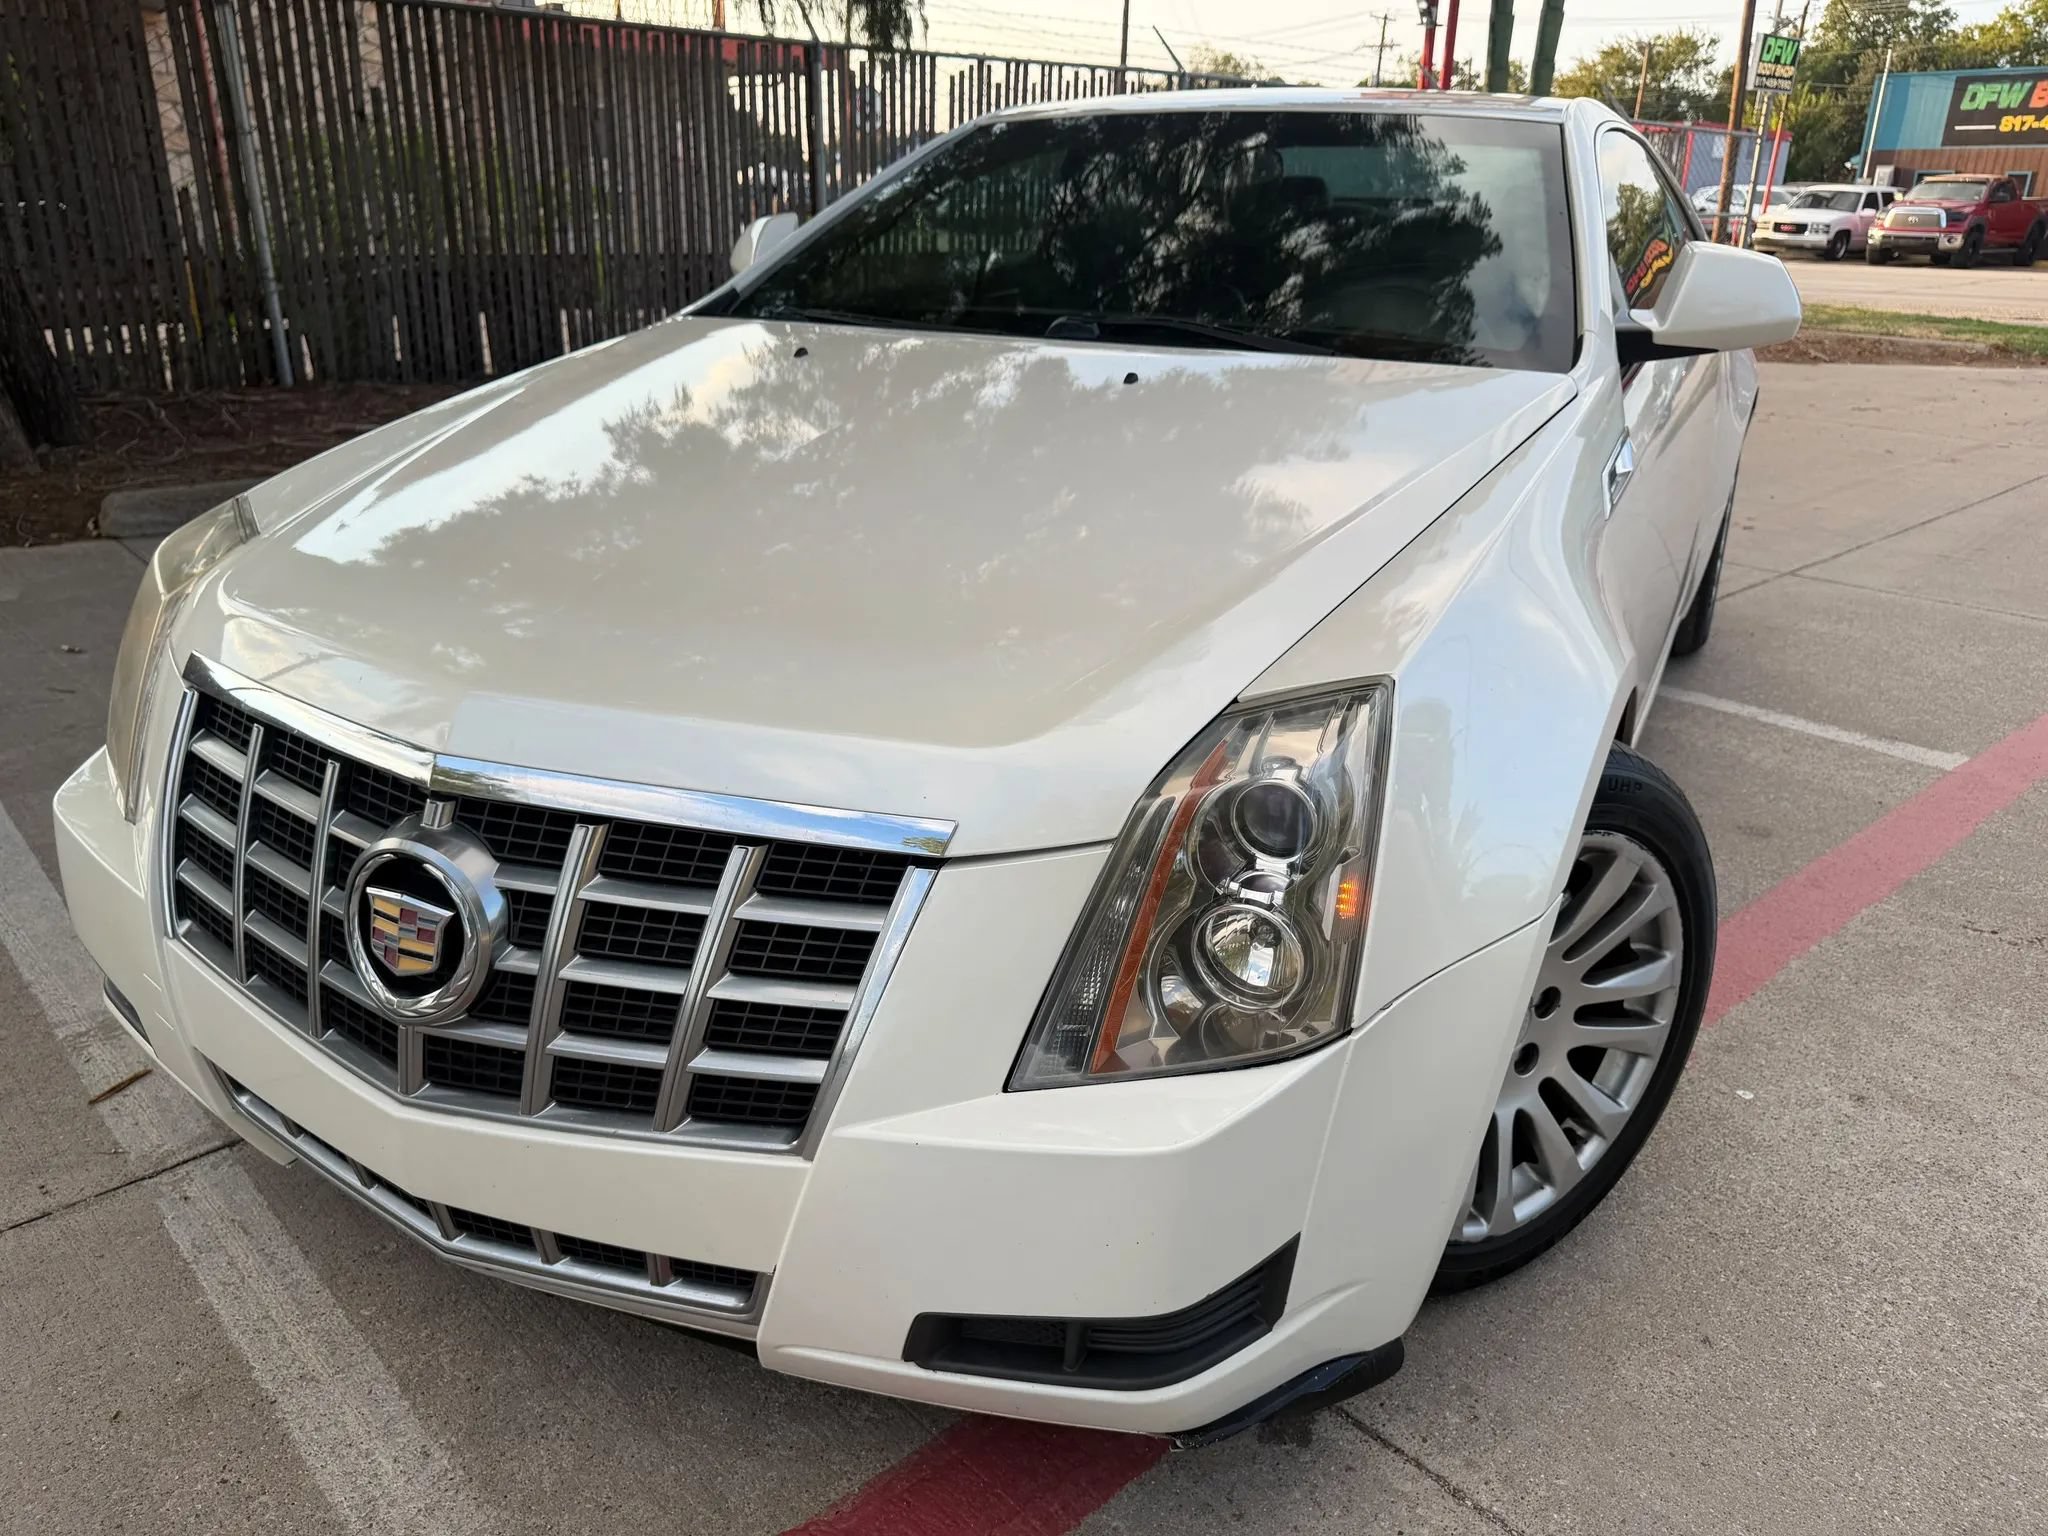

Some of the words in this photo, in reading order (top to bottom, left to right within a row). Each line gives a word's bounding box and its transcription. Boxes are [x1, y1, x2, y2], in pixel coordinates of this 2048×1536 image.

[1761, 37, 1798, 65] DFW
[1960, 82, 2033, 110] DFW
[1608, 777, 1642, 793] UHP
